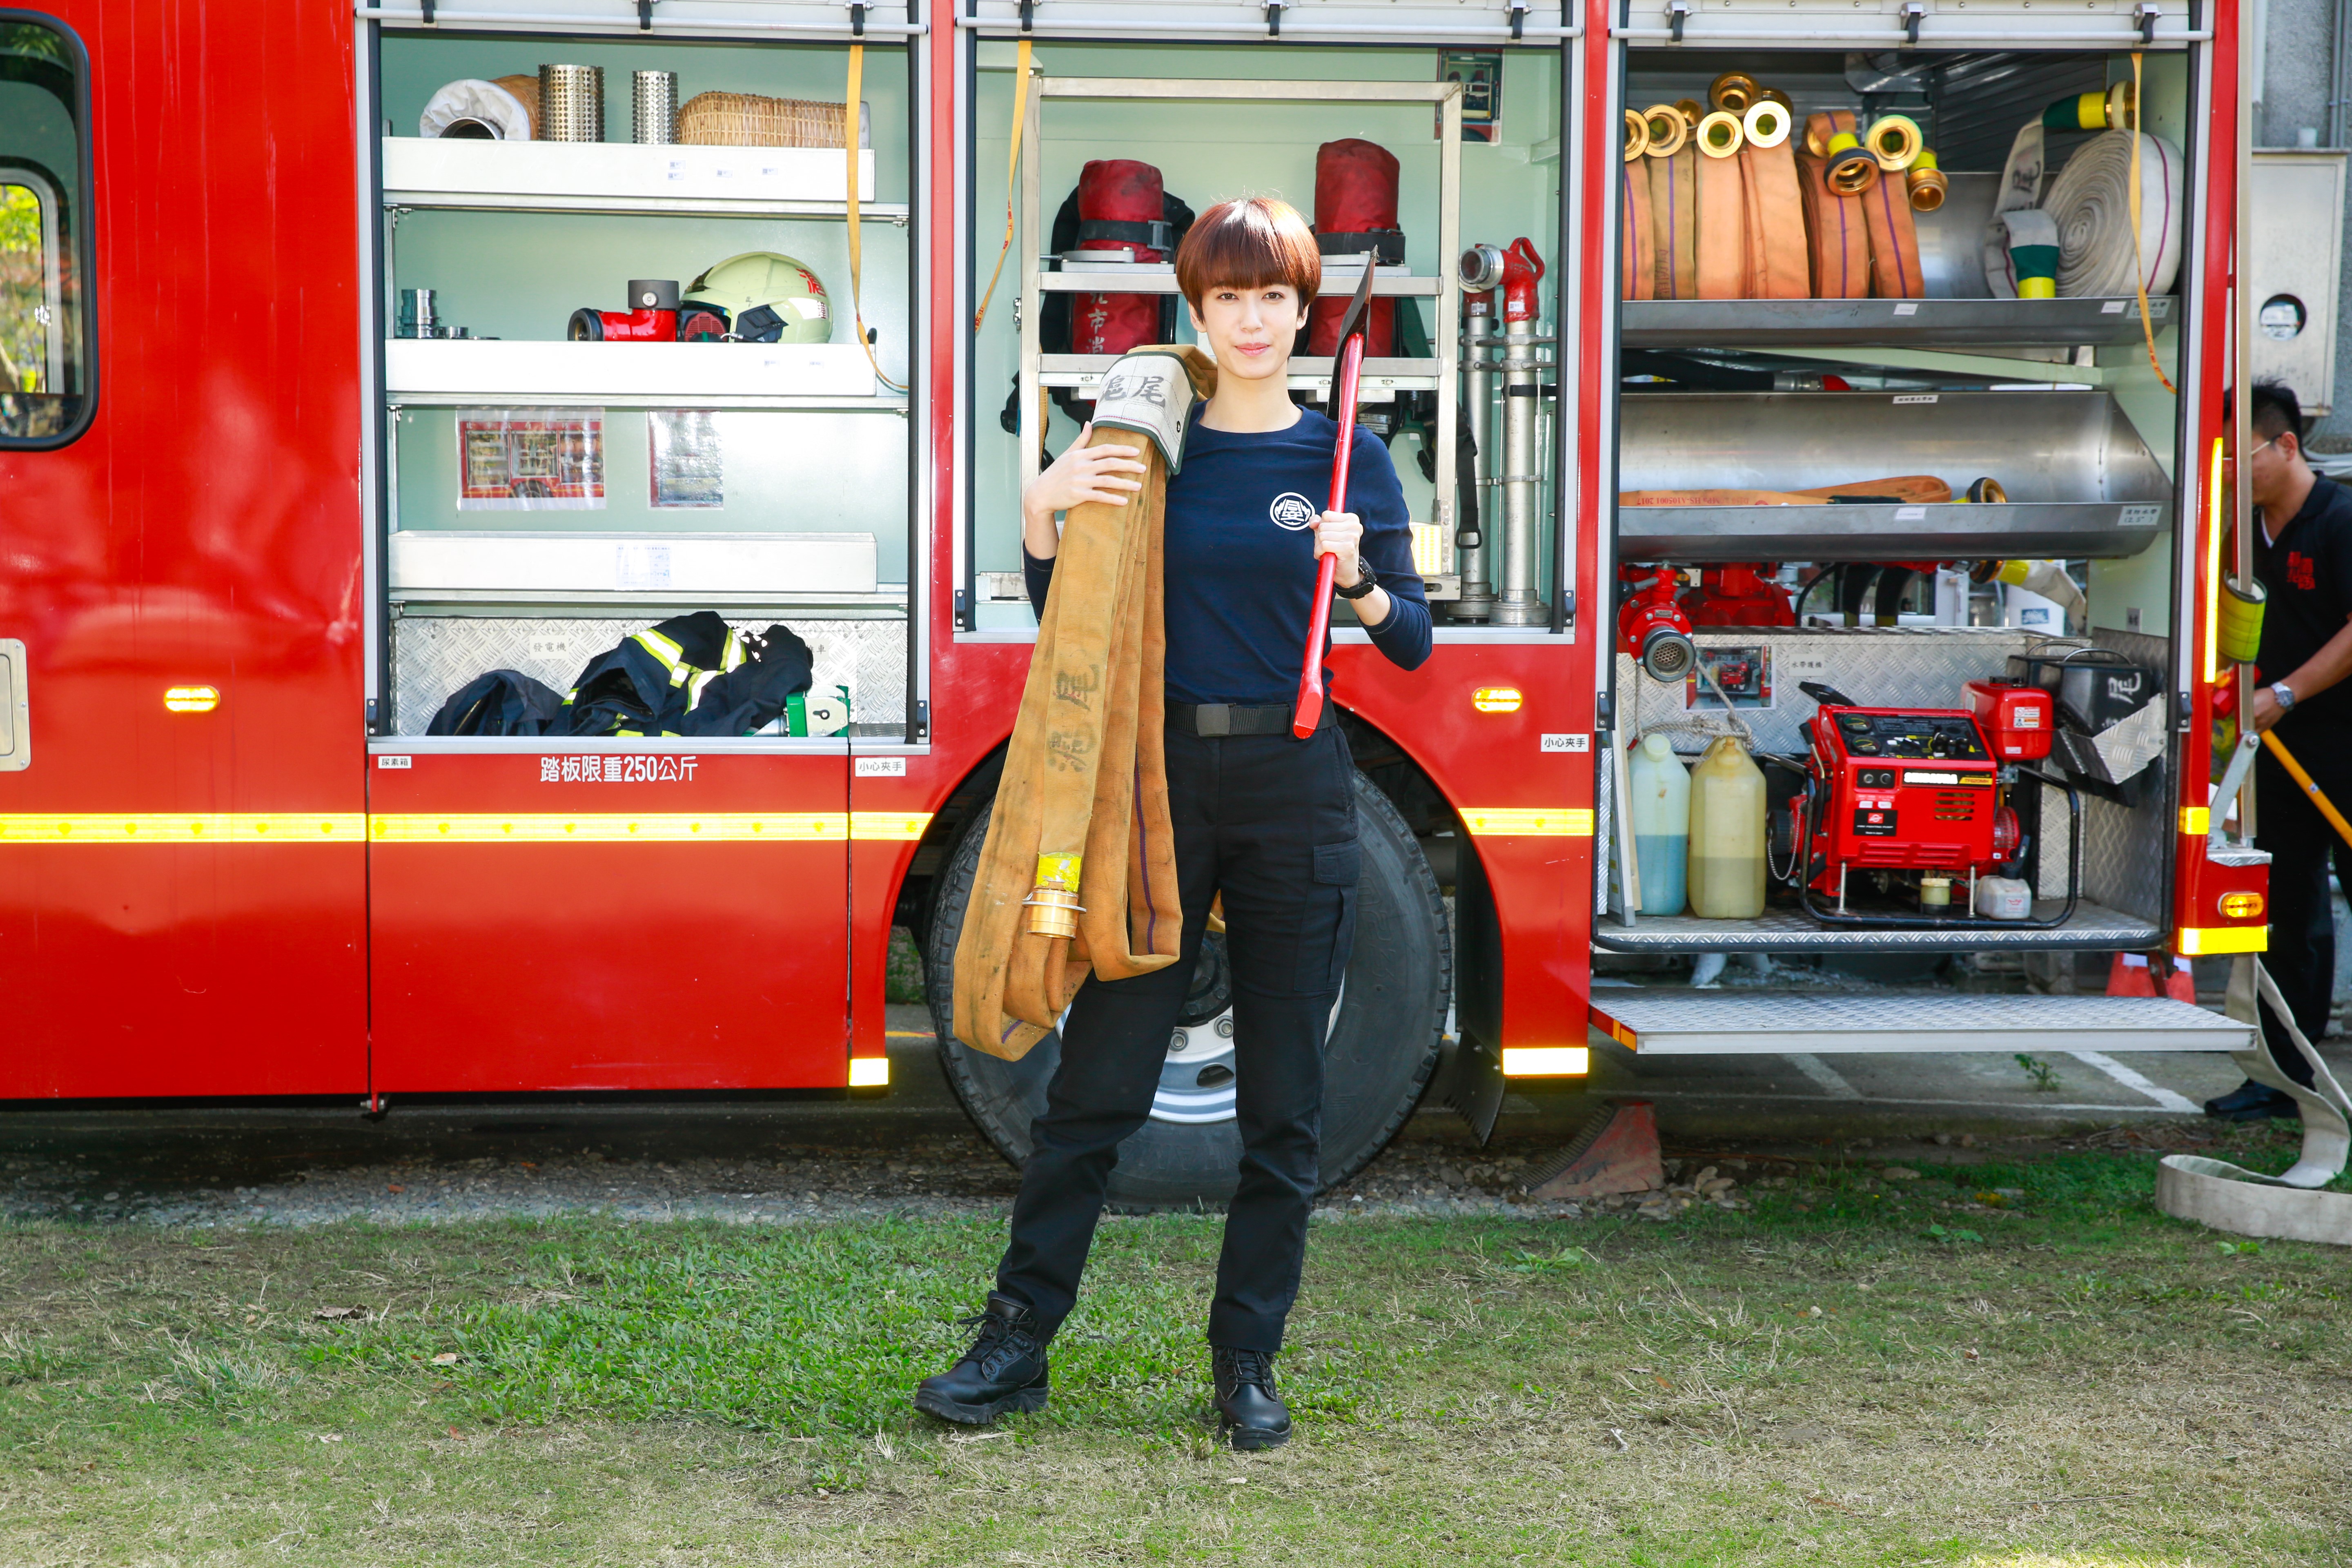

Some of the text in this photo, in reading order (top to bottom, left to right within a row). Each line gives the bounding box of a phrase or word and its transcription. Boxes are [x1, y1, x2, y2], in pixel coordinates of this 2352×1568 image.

[533, 641, 566, 652] 發電機
[1544, 737, 1586, 748] 小心夾手
[382, 758, 408, 766] 尿素箱
[859, 762, 902, 772] 小心夾手
[540, 755, 699, 782] 踏板限重250公斤
